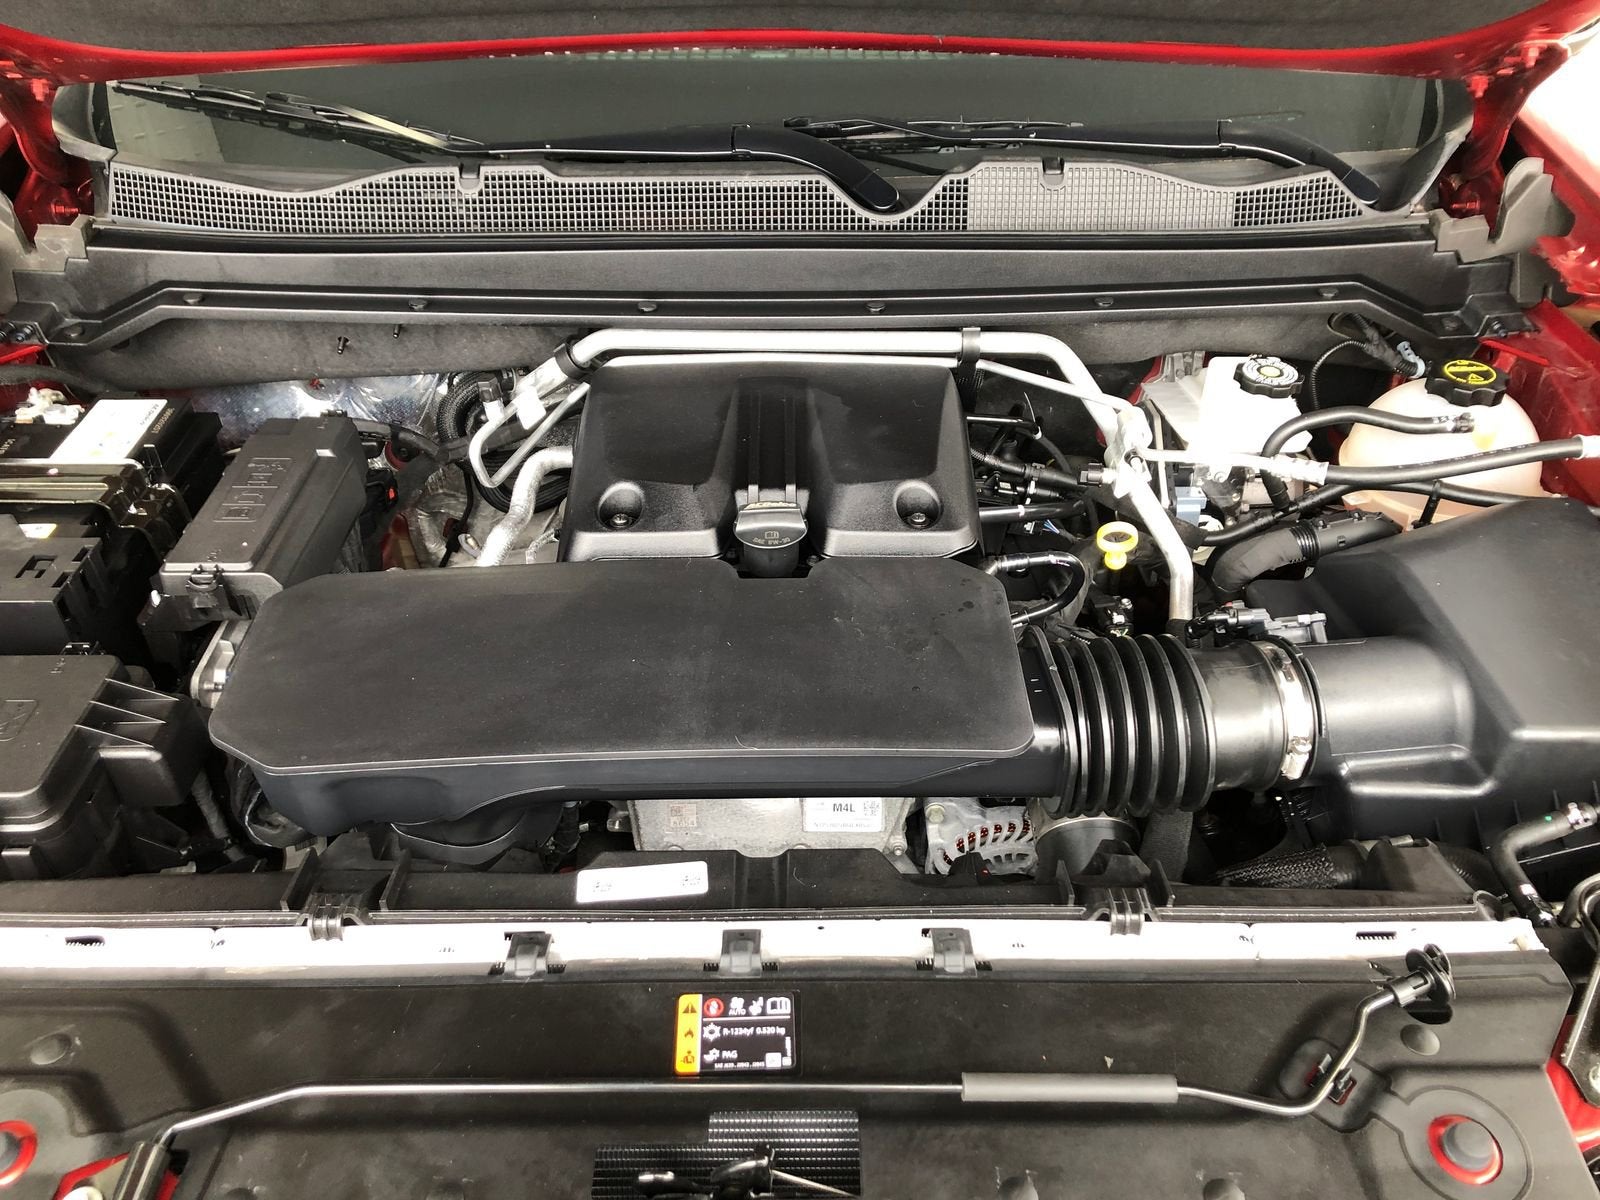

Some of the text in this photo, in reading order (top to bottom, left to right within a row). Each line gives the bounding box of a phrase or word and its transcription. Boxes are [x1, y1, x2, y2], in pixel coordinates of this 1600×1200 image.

[832, 803, 856, 813] M4L
[728, 1008, 746, 1016] AUTO
[723, 1025, 786, 1037] R-1234yf 0.520 kg
[721, 1050, 738, 1059] PAG
